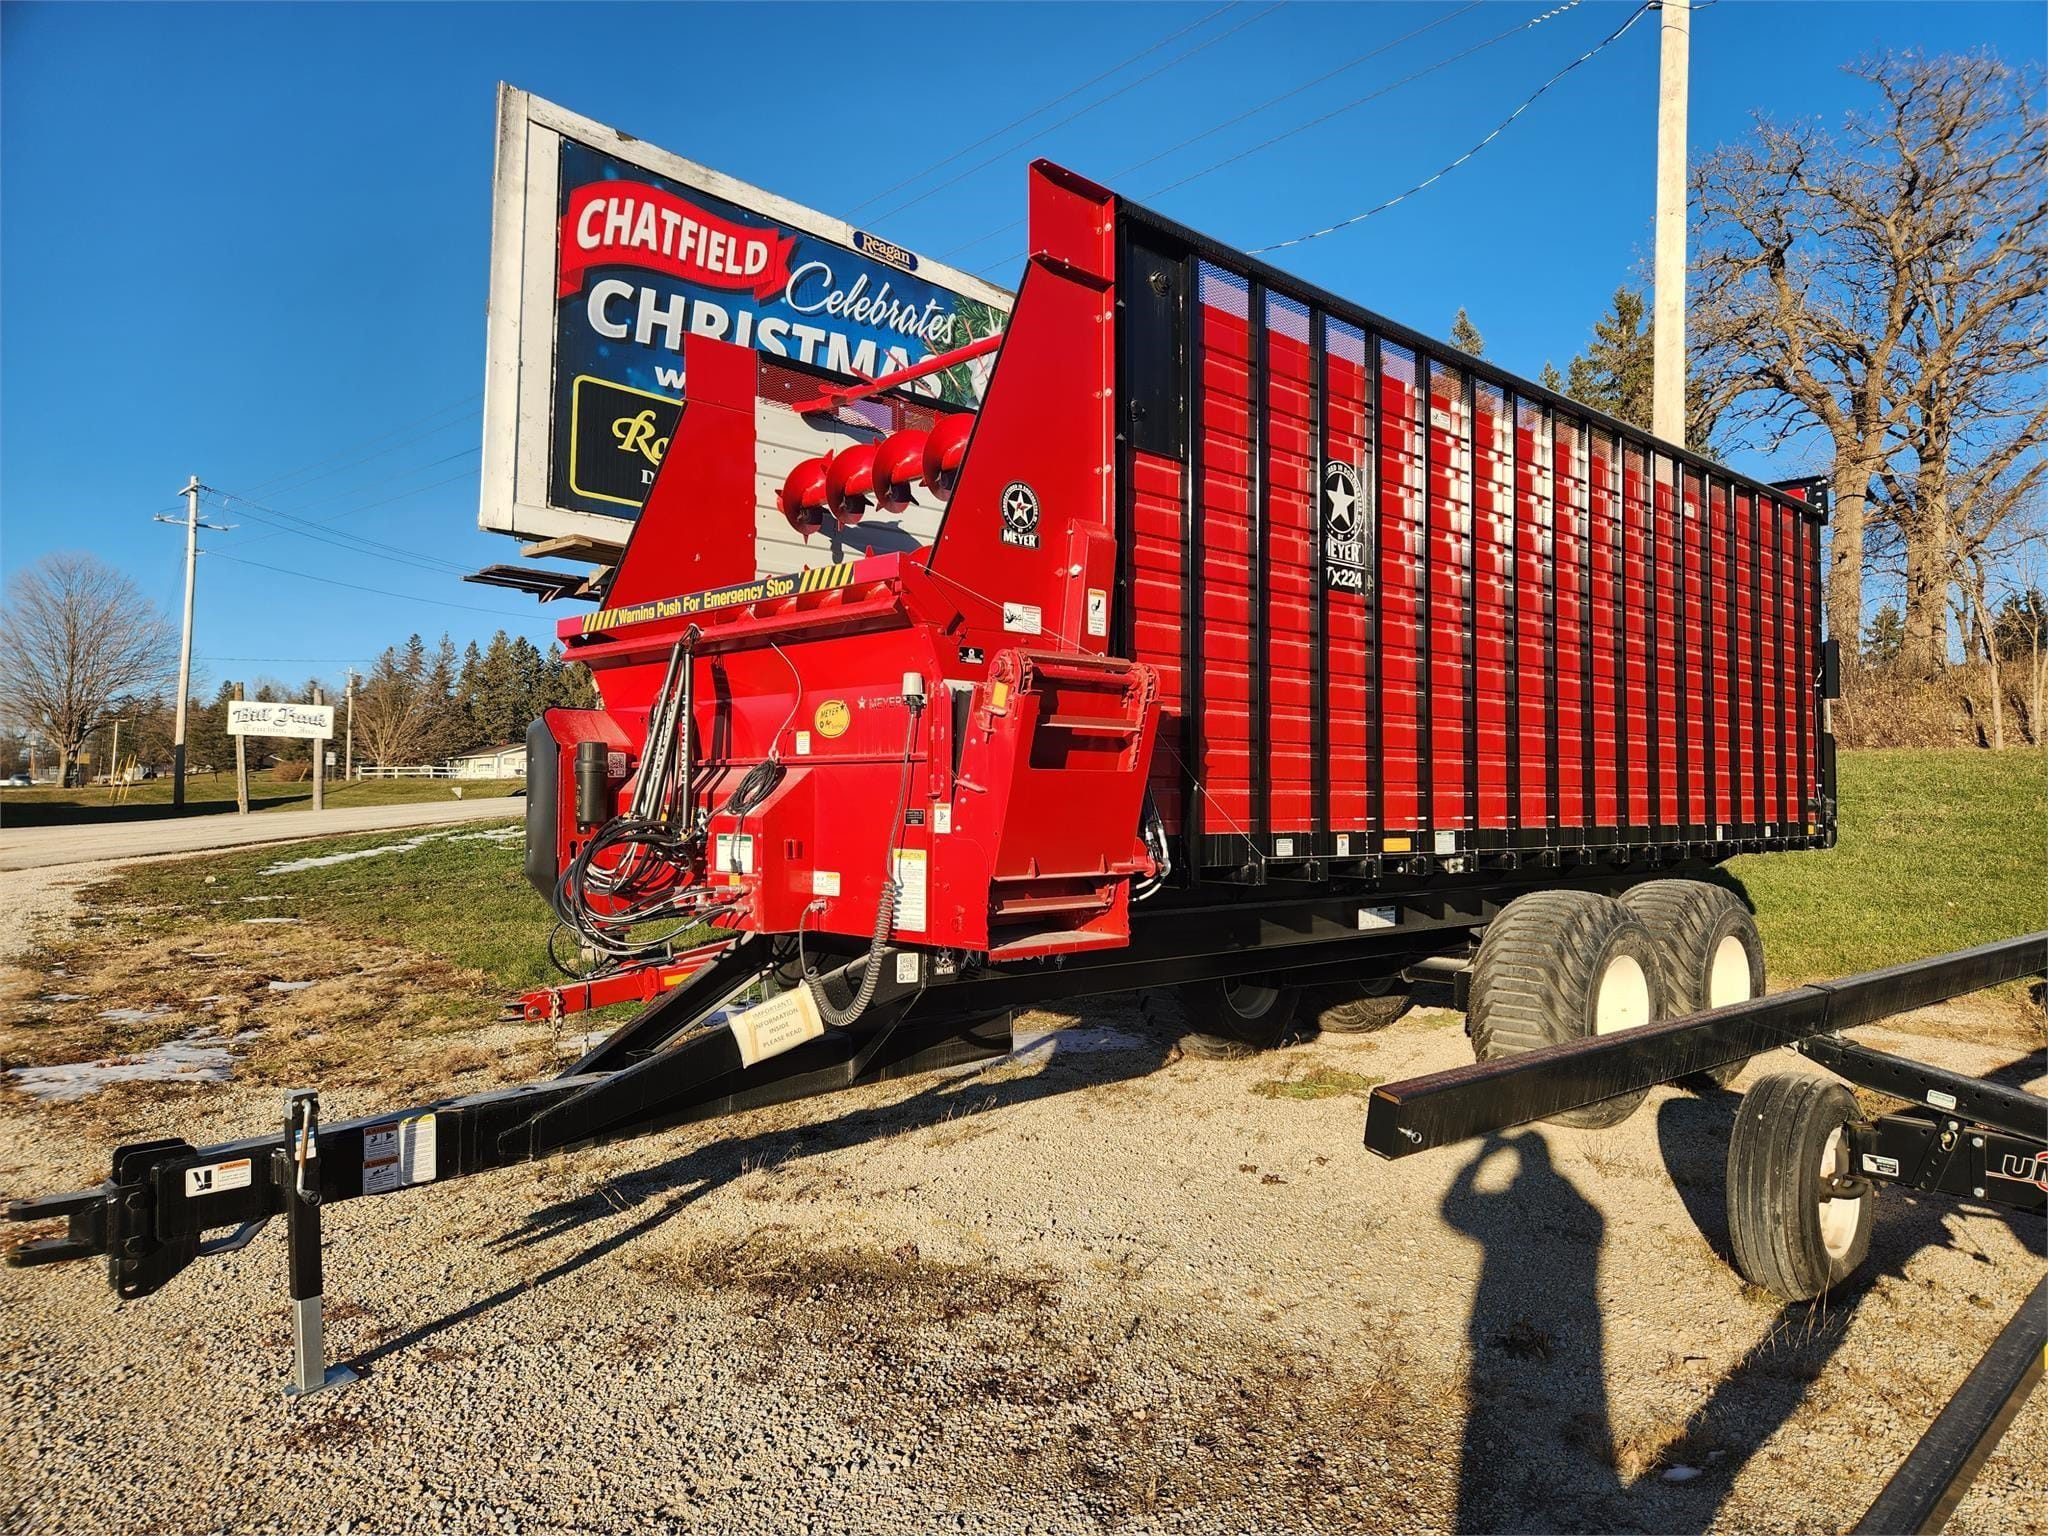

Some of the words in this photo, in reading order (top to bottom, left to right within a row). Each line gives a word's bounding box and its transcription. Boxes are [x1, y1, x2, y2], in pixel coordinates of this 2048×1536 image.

[577, 197, 768, 275] CHATFIELD
[862, 233, 910, 264] Reagan
[785, 260, 956, 344] Celebrates
[1003, 529, 1036, 547] MEYER
[617, 605, 655, 624] Warning
[656, 601, 681, 618] Push
[683, 597, 700, 612] For
[703, 584, 764, 609] Emergency
[766, 578, 794, 598] Stop
[753, 1008, 799, 1031] INFORMATION
[769, 1022, 789, 1034] INSIDE
[763, 1034, 785, 1048] PLEASE
[786, 1027, 802, 1038] READ
